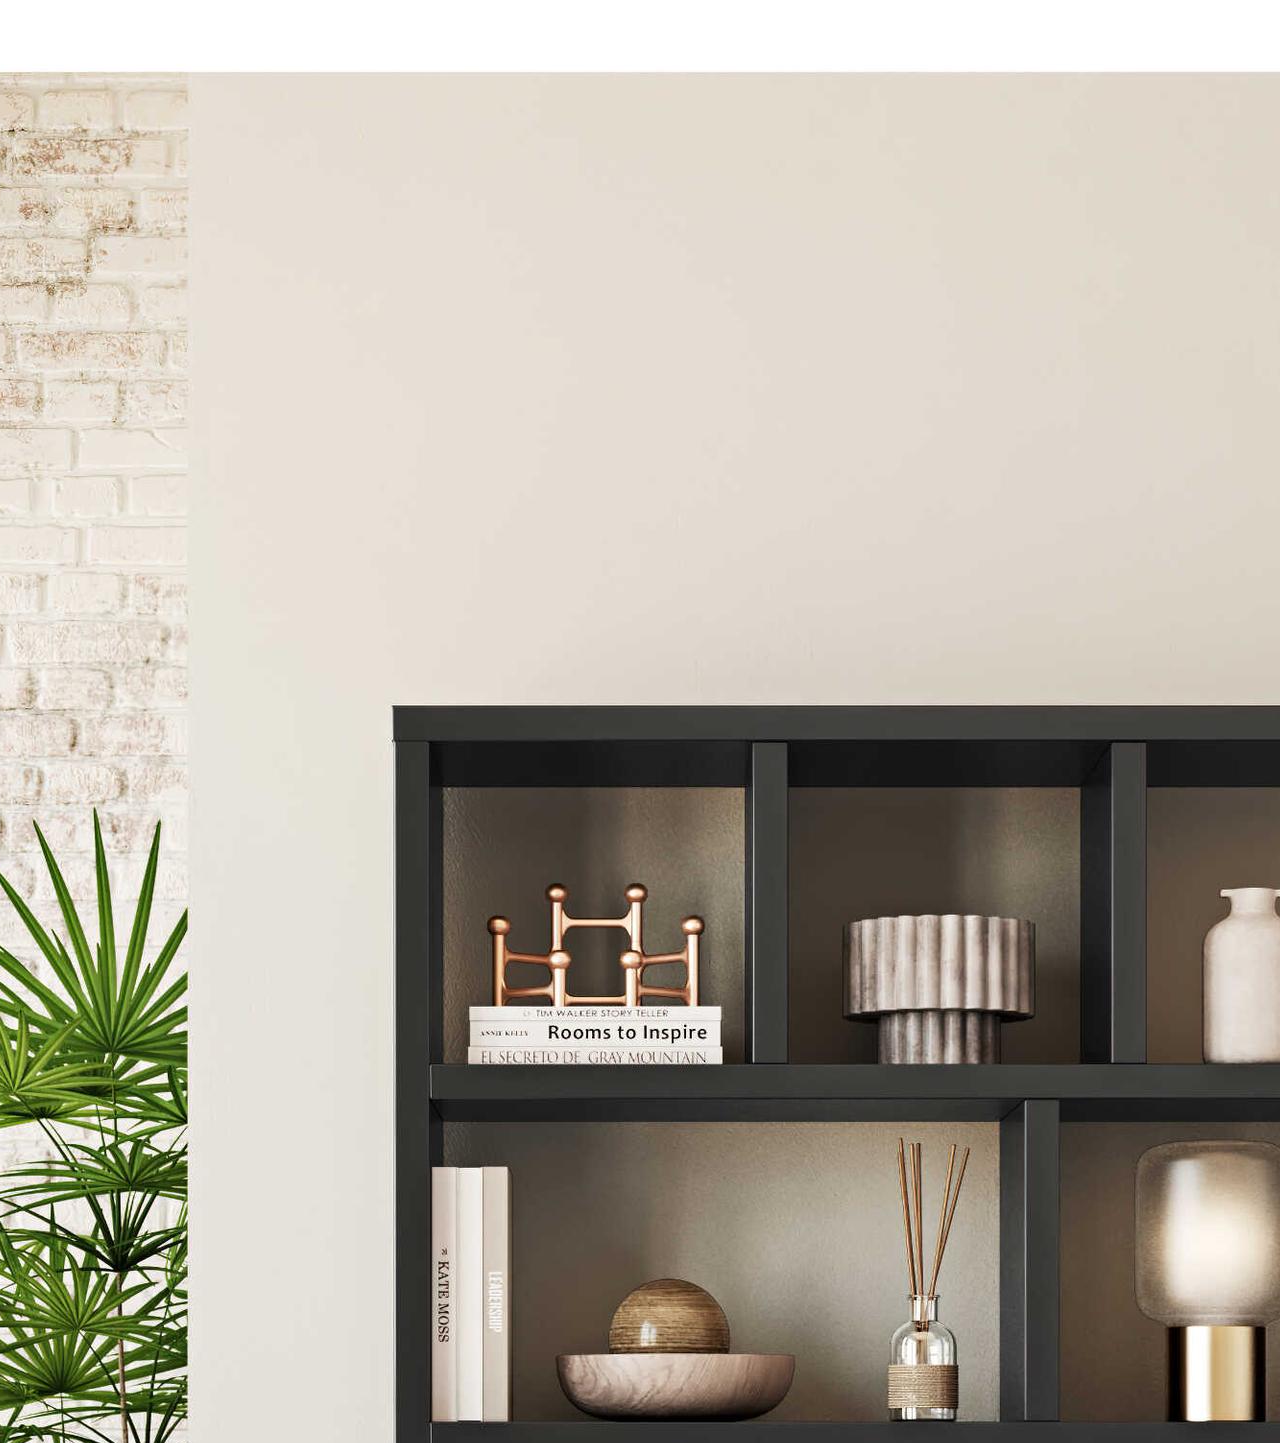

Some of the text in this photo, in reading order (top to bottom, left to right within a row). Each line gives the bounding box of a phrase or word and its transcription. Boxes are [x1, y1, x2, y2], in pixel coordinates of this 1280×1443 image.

[556, 1009, 597, 1018] WALKER
[601, 1009, 632, 1018] STORY
[636, 1009, 669, 1018] TELLER
[548, 1025, 708, 1044] Rooms to Inspire
[481, 1051, 708, 1064] EL SECRETO DE GRAY MOUNTAIN
[437, 1261, 449, 1343] KATE MOSS
